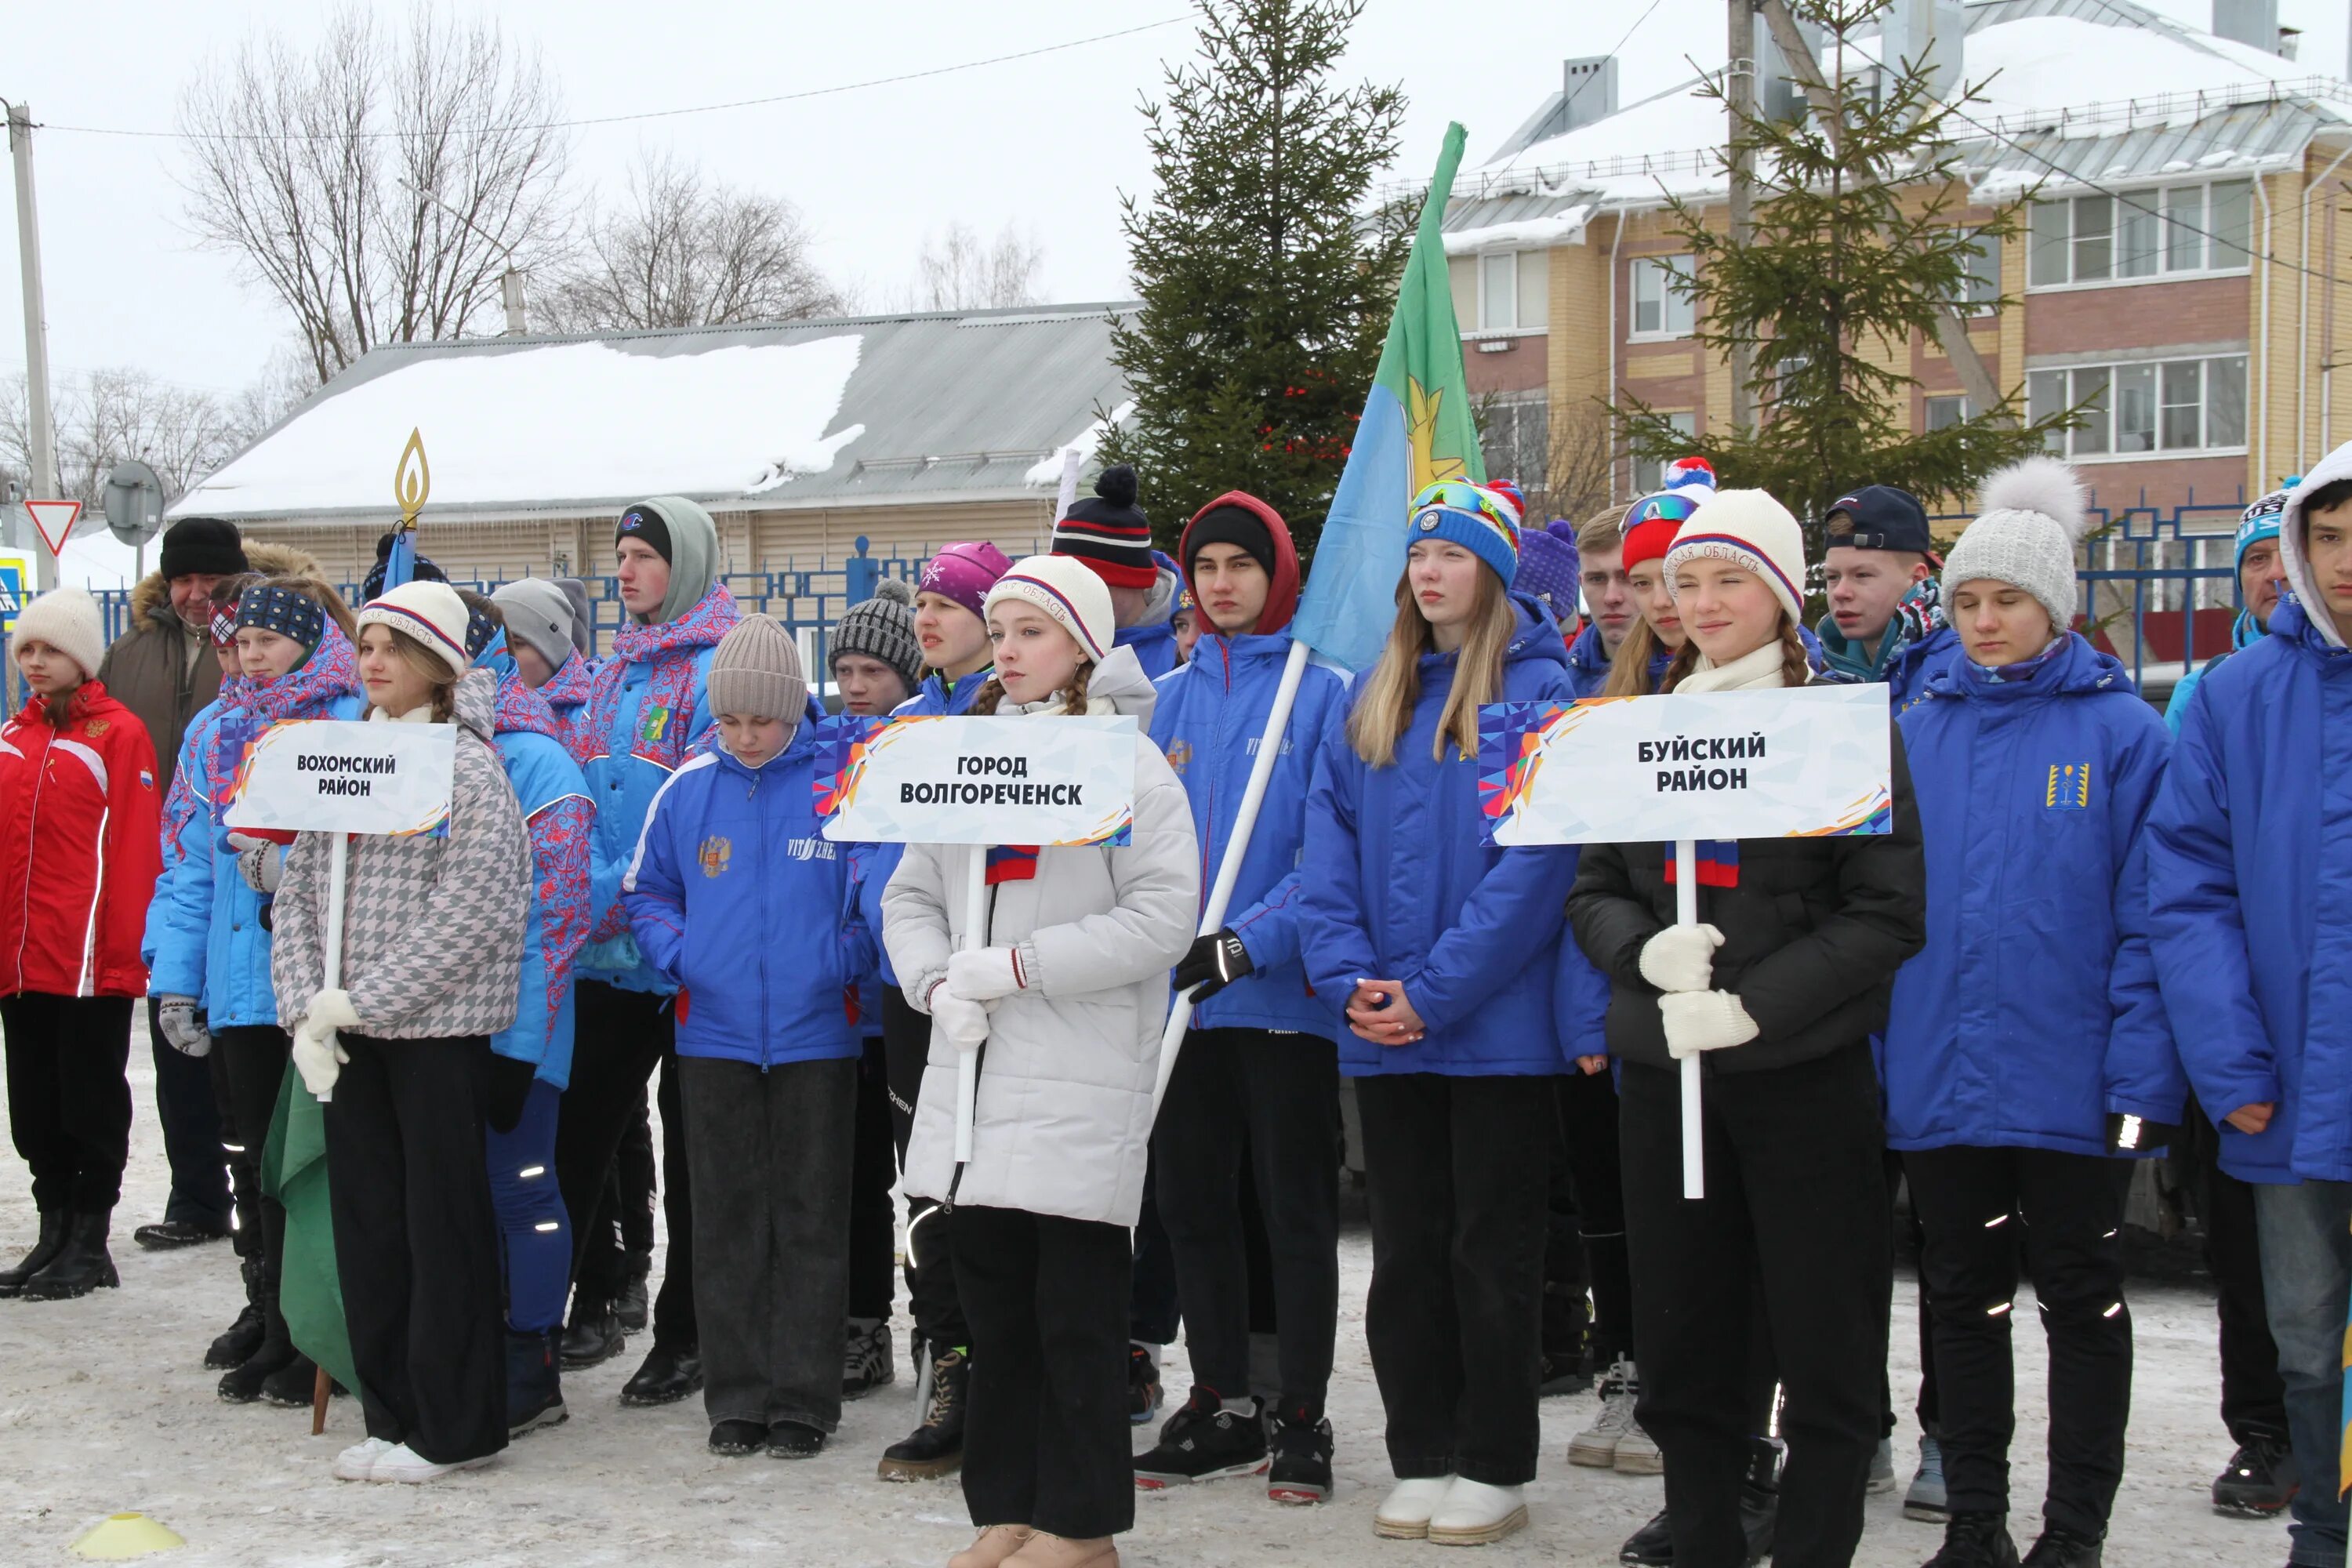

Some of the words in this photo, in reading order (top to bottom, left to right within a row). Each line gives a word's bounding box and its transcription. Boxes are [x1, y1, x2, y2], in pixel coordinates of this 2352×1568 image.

[1704, 545, 1759, 572] ОБЛАСТЬ
[1023, 585, 1066, 622] ОБЛАСТЬ
[390, 615, 433, 644] ОБЛАСТЬ
[1638, 731, 1766, 762] БУЙСКИЙ
[297, 754, 396, 774] ВОХОМСКИЙ
[957, 757, 1028, 778] ГОРОД
[318, 776, 371, 796] РАЙОН
[1657, 764, 1747, 792] РАЙОН
[900, 782, 1083, 805] ВОЛГОРЕЧЕНСК
